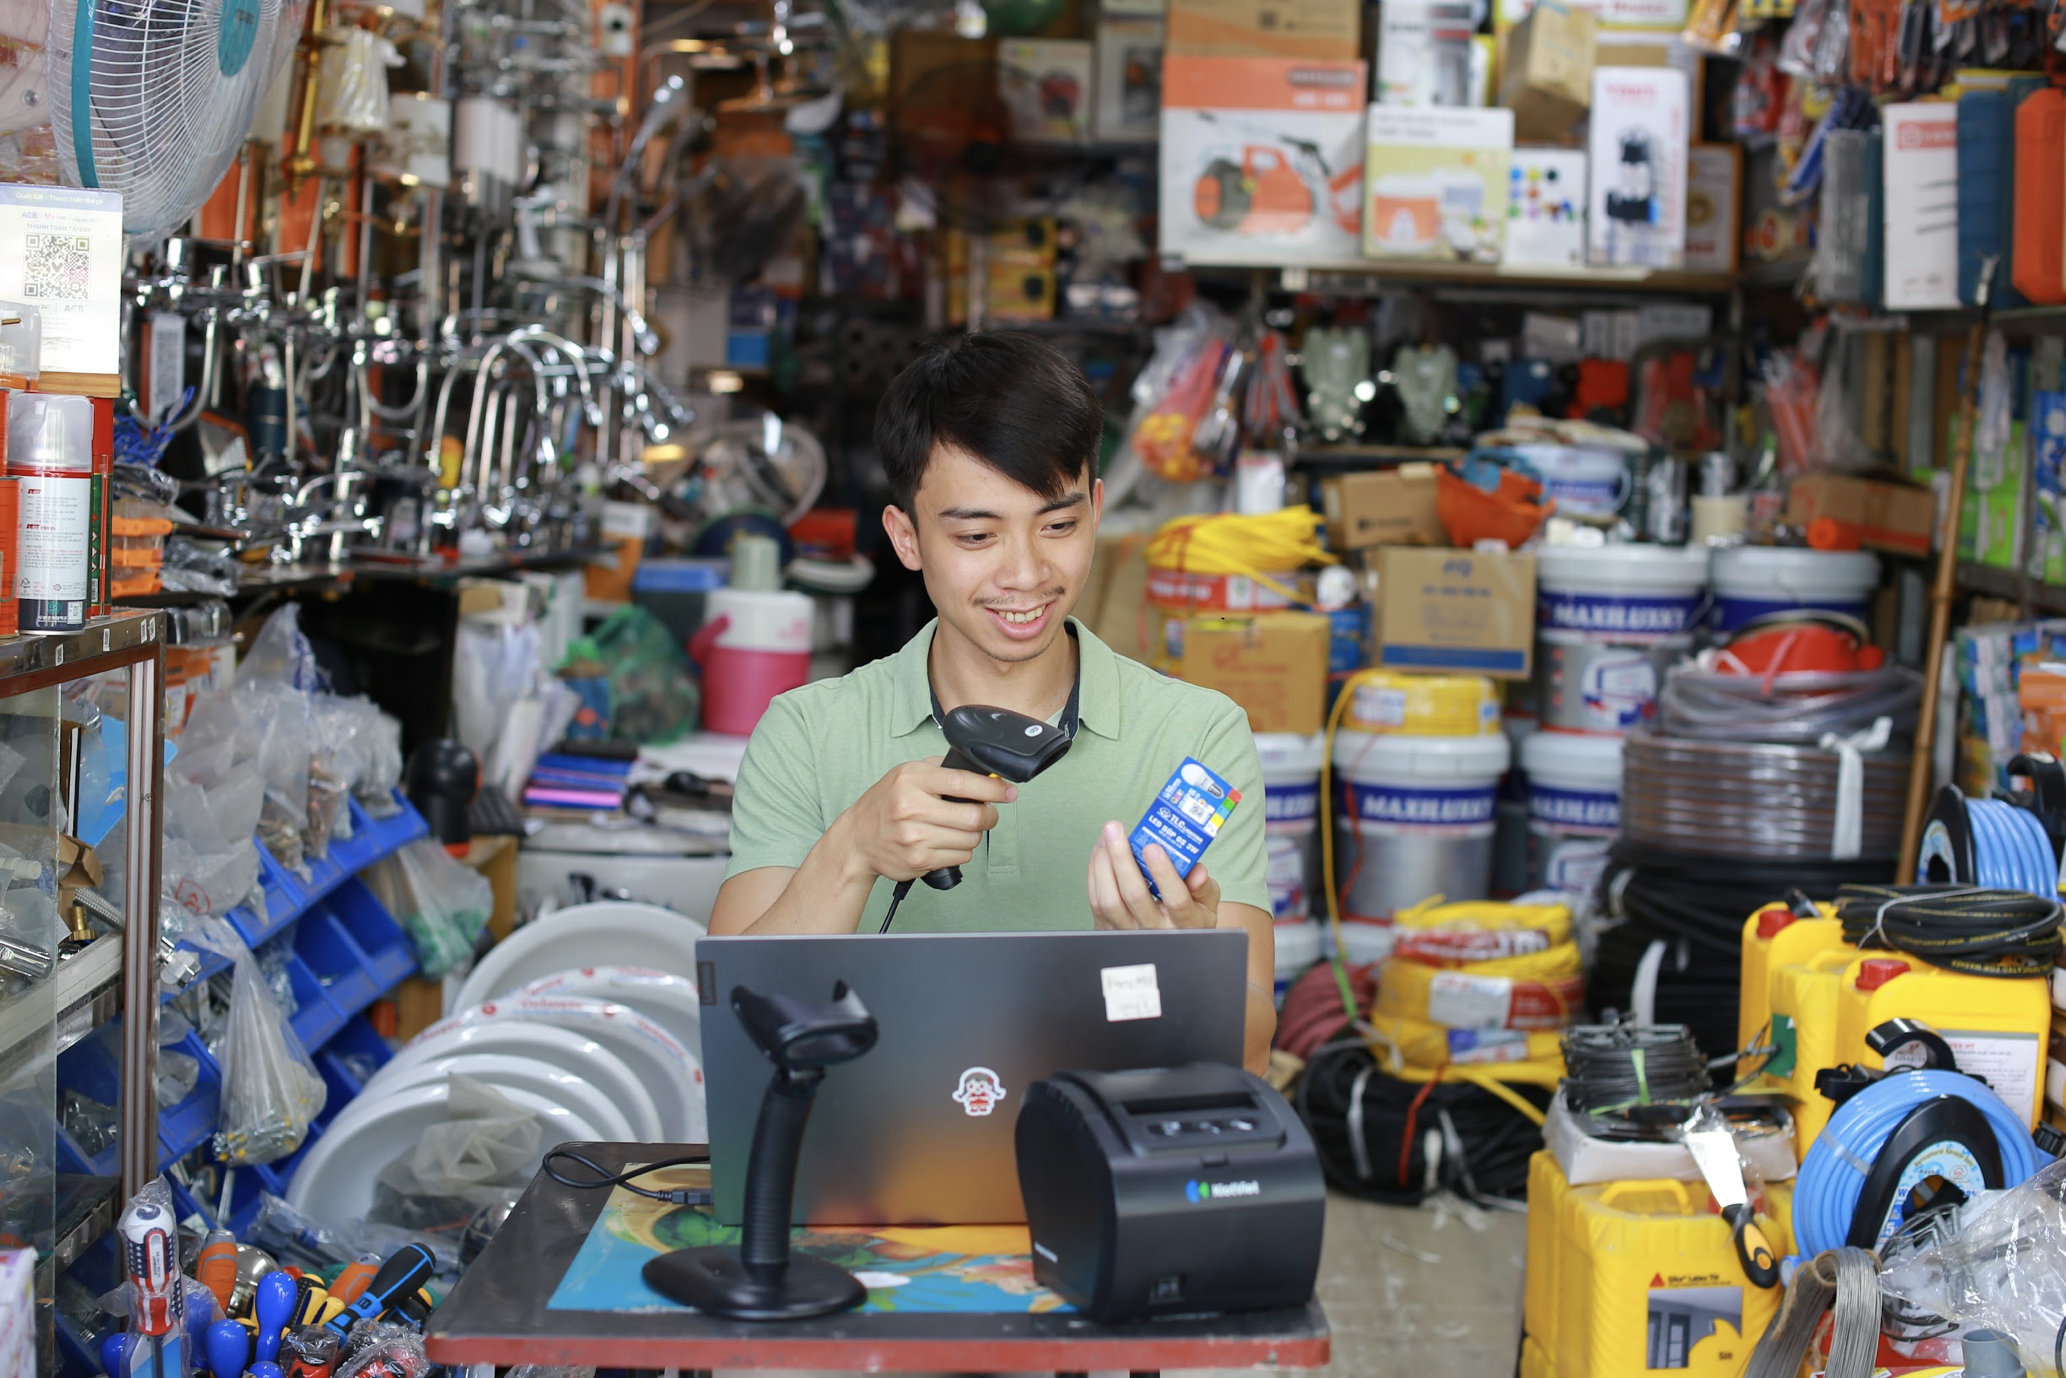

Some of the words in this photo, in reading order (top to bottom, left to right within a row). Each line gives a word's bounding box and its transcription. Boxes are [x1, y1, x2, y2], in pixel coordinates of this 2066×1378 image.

[48, 194, 69, 203] Thanh
[21, 211, 38, 219] ACB
[64, 304, 85, 313] ACB
[1169, 814, 1186, 829] TLC
[1148, 814, 1163, 829] LED
[1186, 843, 1200, 855] 3W
[1211, 1179, 1261, 1198] KiotViet
